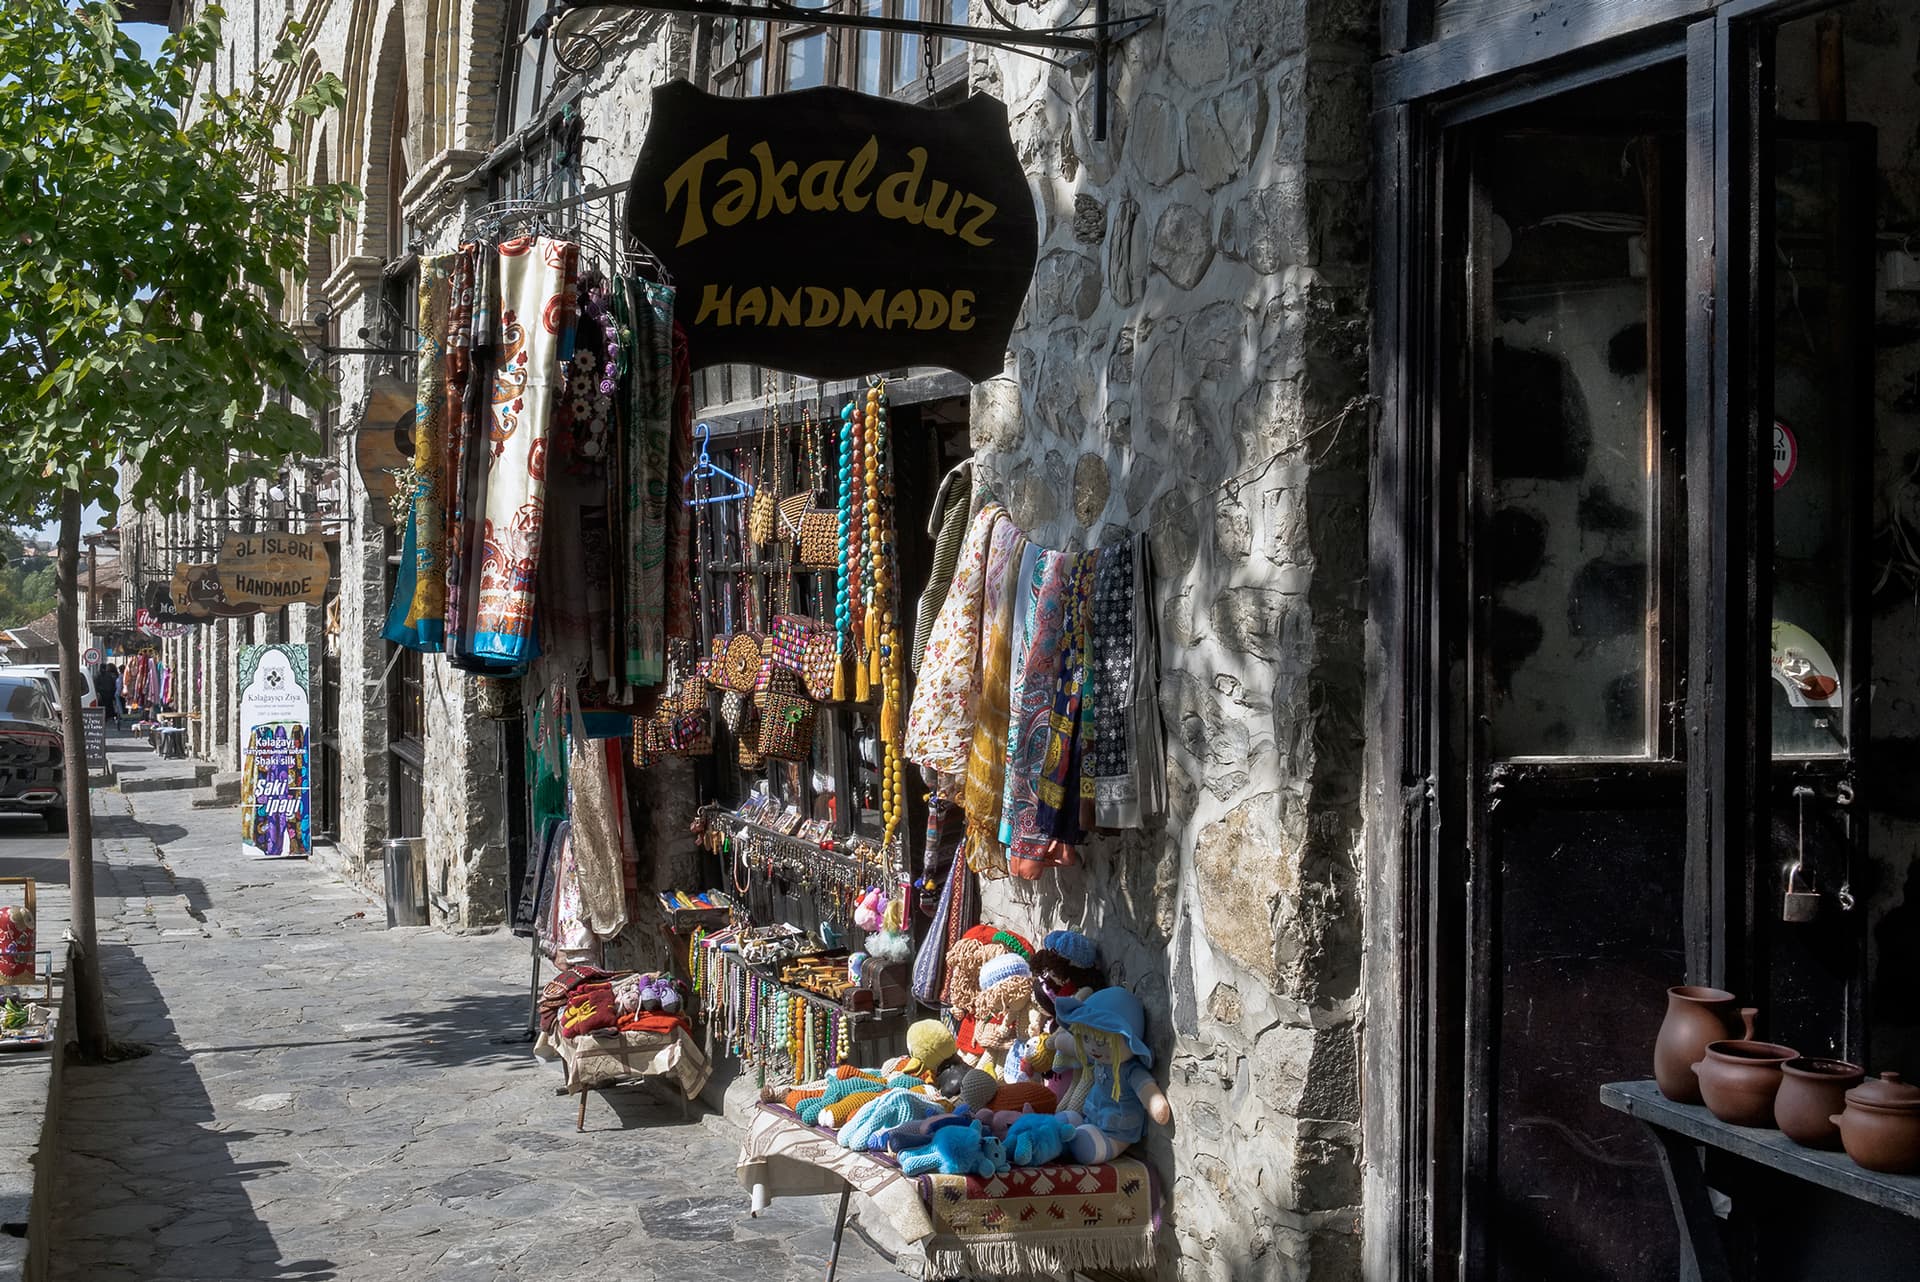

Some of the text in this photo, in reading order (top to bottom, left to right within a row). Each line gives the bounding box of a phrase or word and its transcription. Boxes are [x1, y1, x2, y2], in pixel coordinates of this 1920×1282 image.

[694, 284, 976, 331] HANDMADE
[236, 574, 312, 597] HANDMADE
[87, 652, 97, 660] 40
[255, 755, 295, 765] Shaki silk
